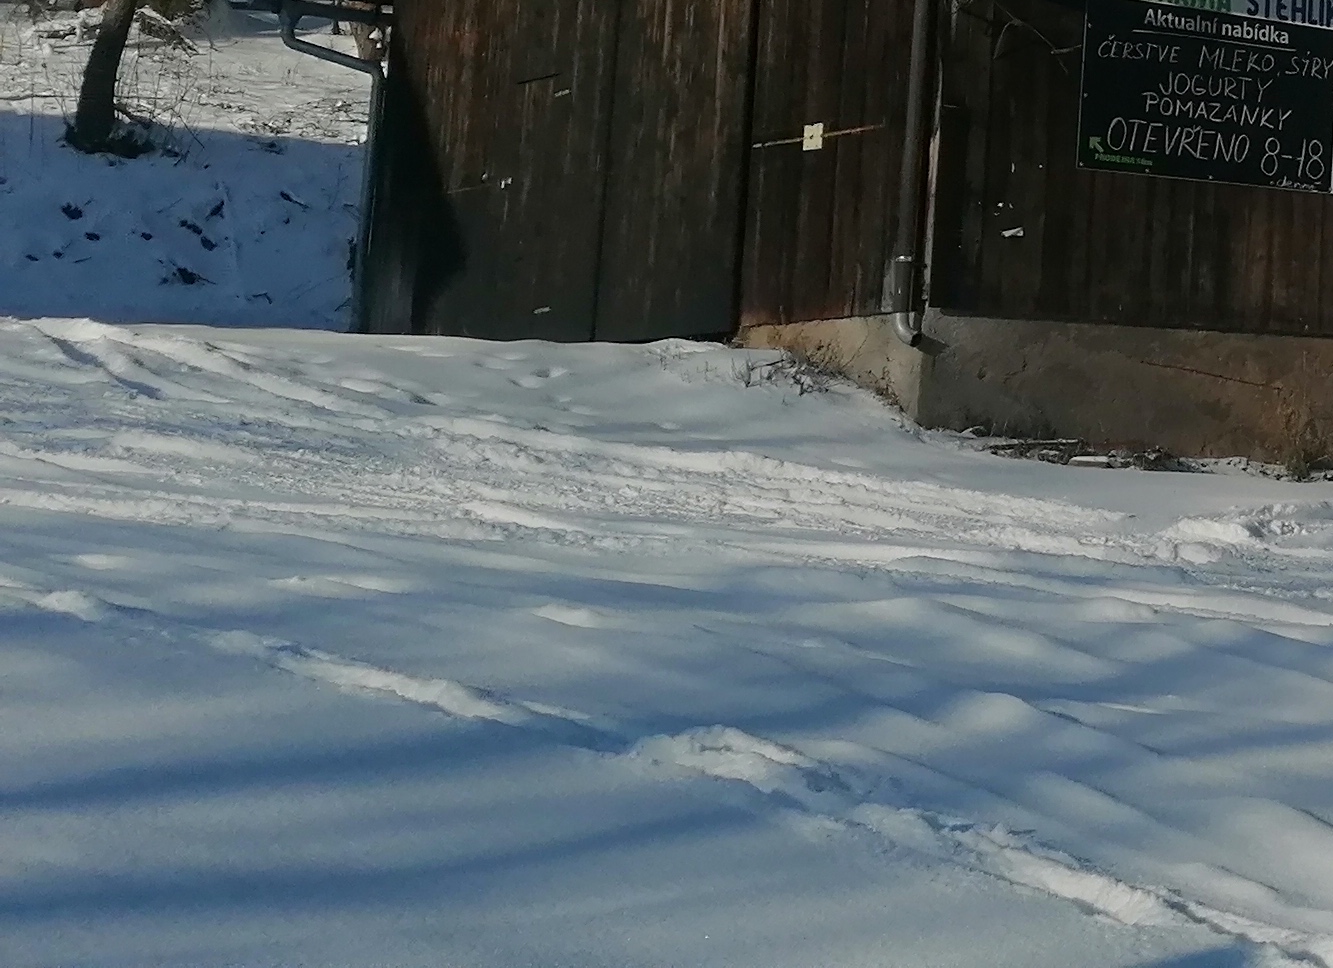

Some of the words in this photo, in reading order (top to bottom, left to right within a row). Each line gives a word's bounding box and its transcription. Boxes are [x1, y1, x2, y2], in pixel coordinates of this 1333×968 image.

[1144, 9, 1218, 33] Aktualní
[1222, 20, 1289, 44] nabídka
[1159, 72, 1273, 103] JOGURTY
[1107, 117, 1250, 164] OTEVŘENO
[1260, 136, 1325, 180] 8-18
